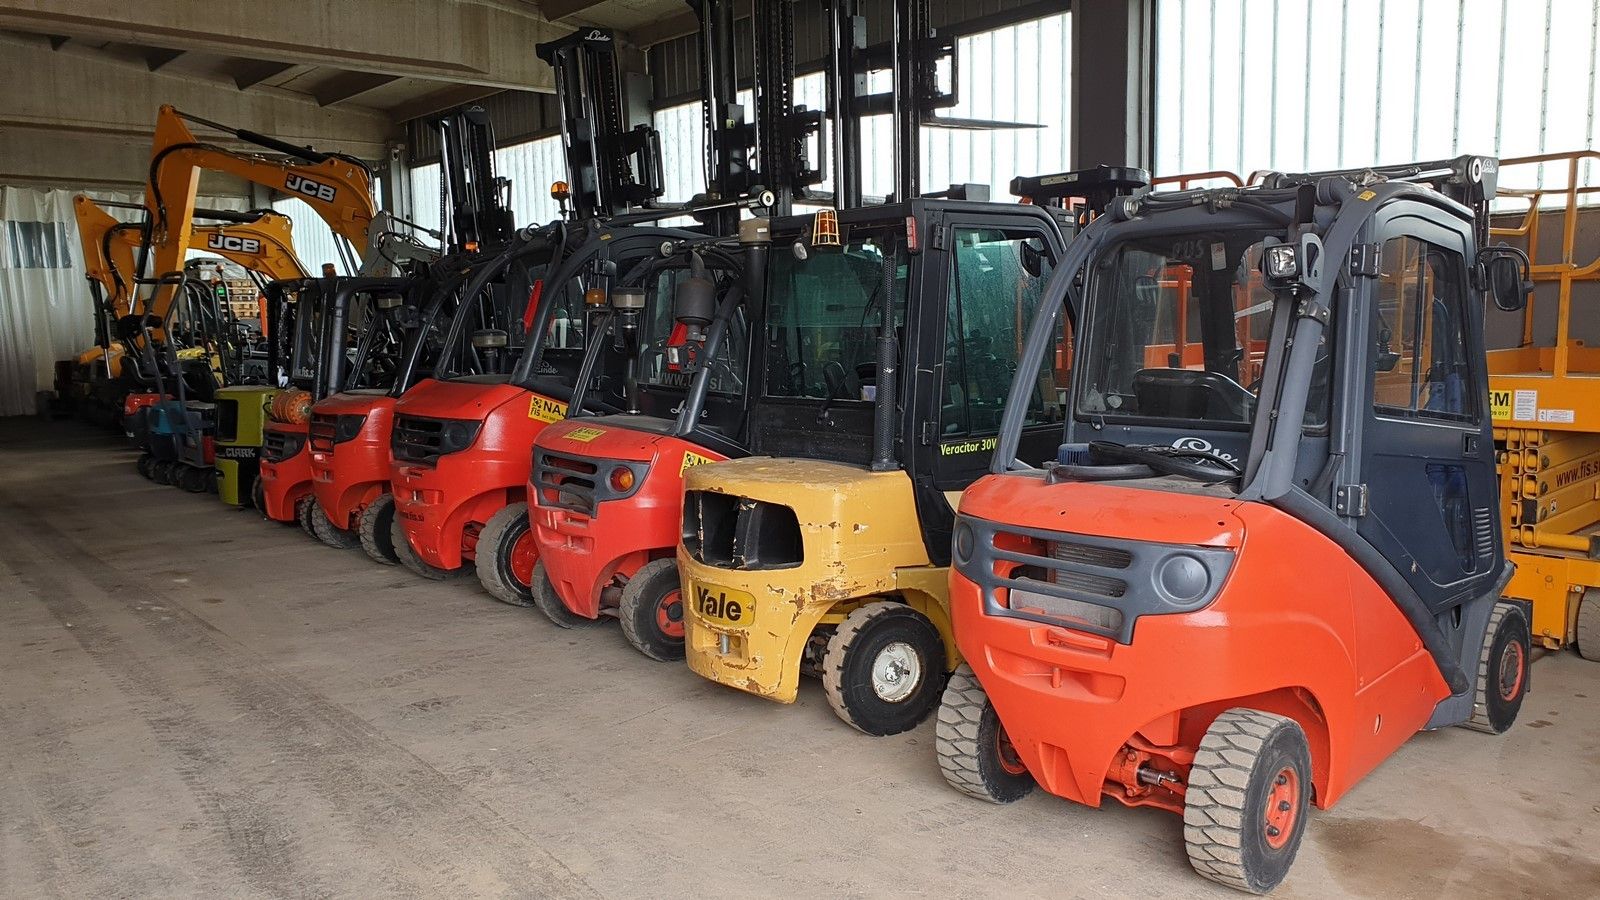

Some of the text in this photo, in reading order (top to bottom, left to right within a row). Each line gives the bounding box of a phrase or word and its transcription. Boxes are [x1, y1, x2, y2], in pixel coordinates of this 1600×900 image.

[286, 176, 336, 202] JCB
[208, 235, 259, 253] JCB
[225, 448, 256, 458] CLARK
[940, 441, 980, 456] Veracitor
[697, 585, 742, 622] Yale
